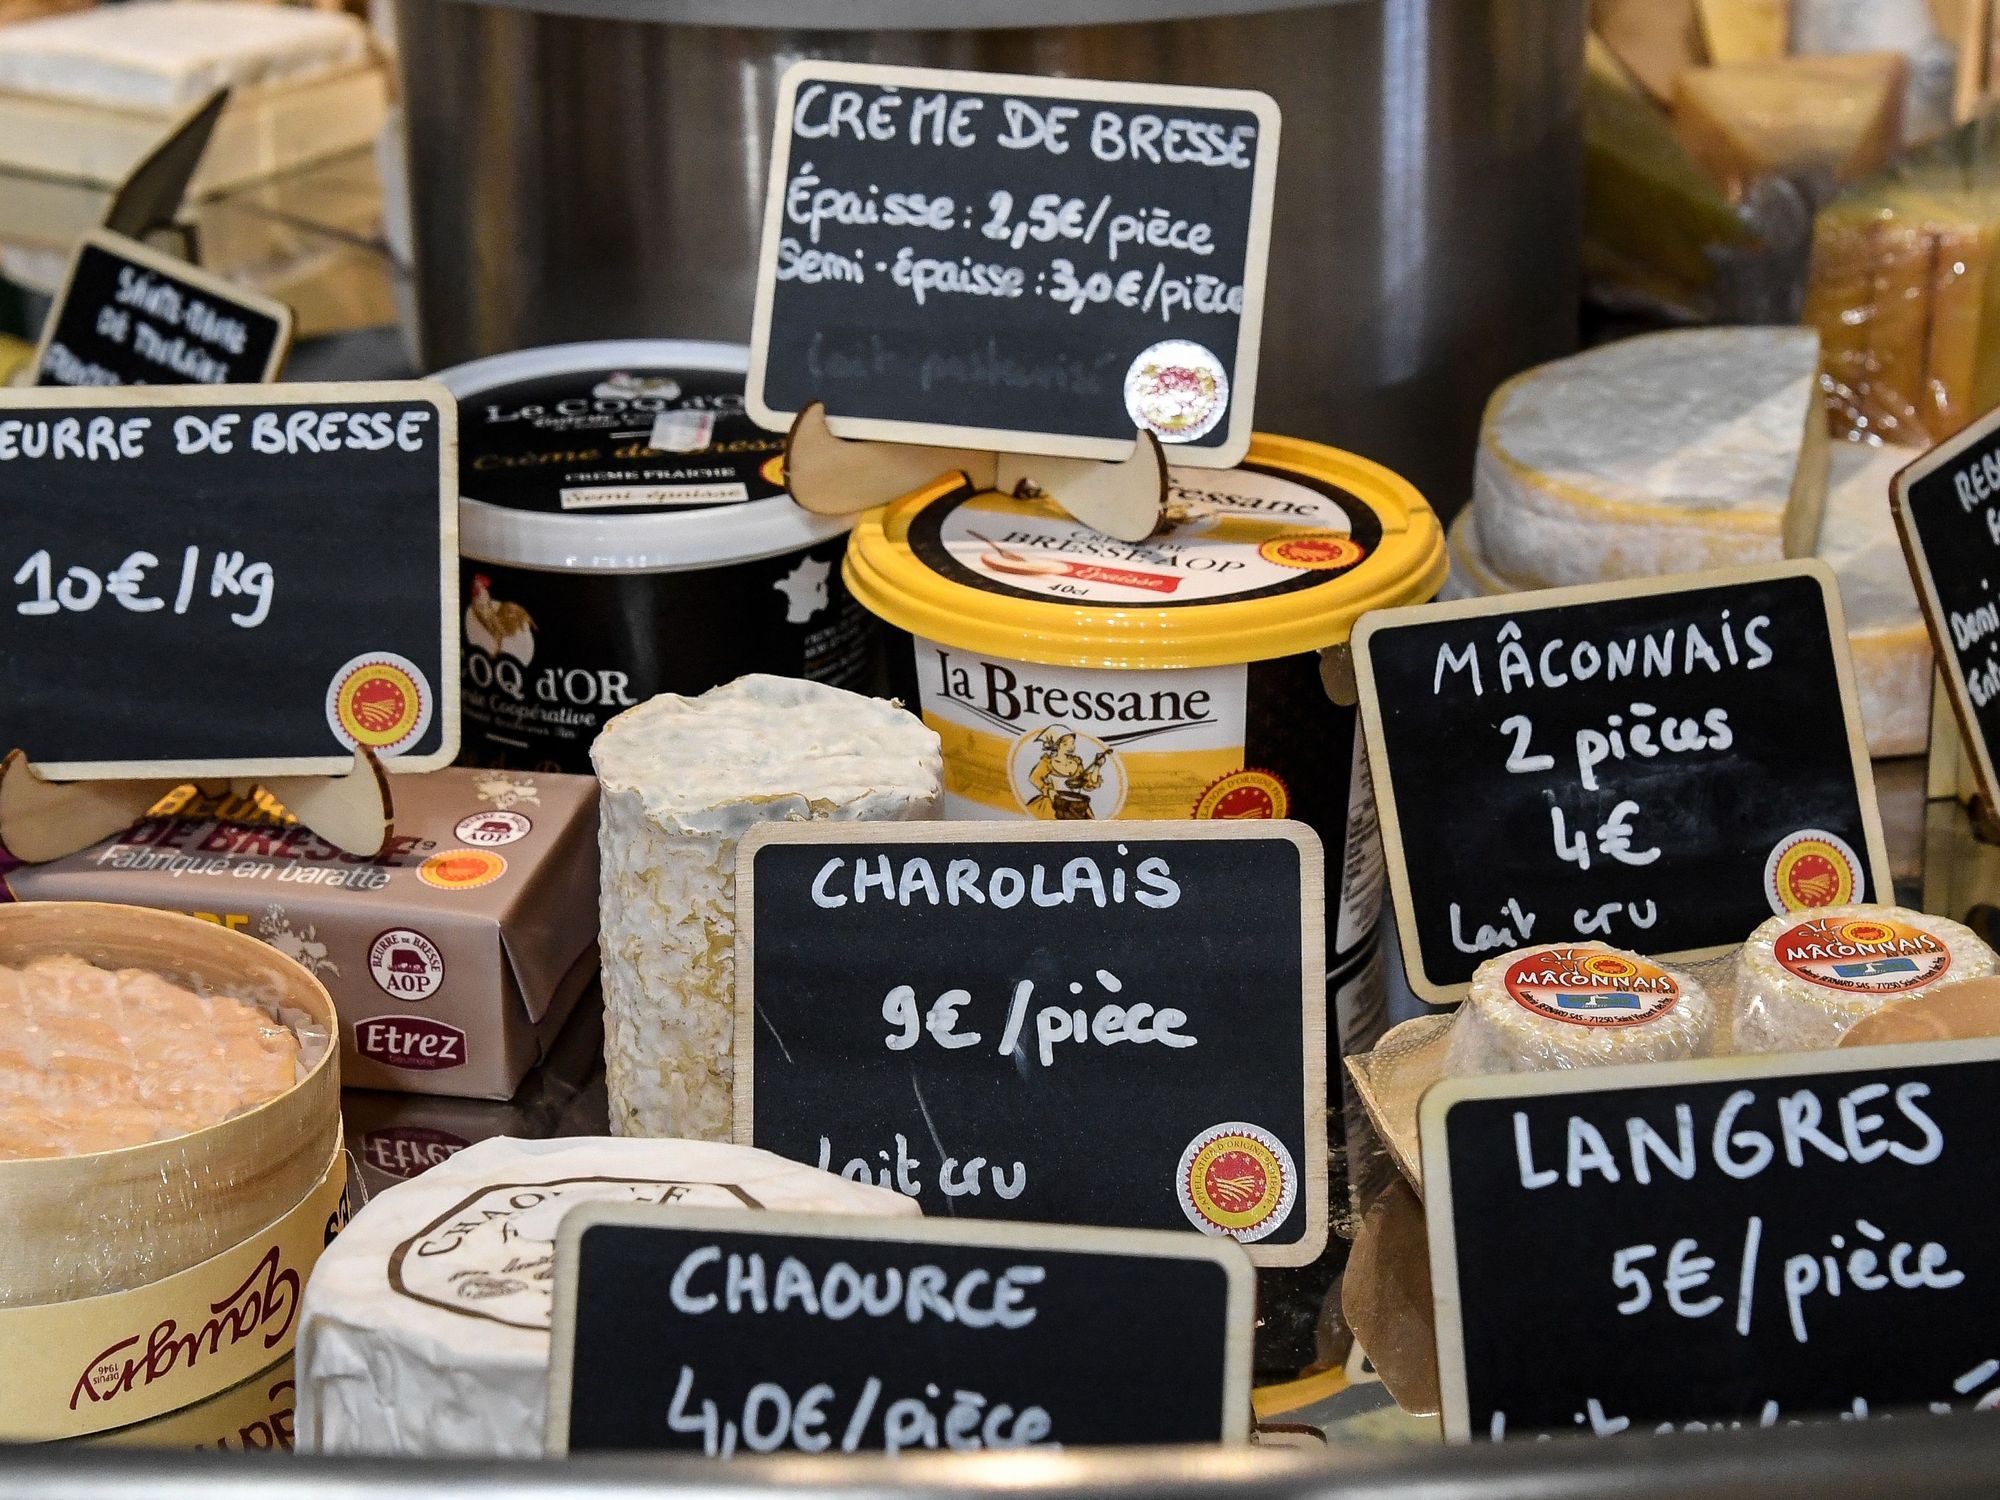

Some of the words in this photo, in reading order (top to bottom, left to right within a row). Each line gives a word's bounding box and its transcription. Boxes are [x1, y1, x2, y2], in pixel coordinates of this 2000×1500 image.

[997, 98, 1081, 155] DE
[1090, 111, 1257, 169] BRESSE
[173, 413, 241, 455] DE
[250, 410, 431, 454] BRESSE
[535, 667, 639, 707] d'OR
[979, 661, 1213, 723] Bressane
[1501, 714, 1555, 773] 2
[1576, 702, 1735, 792] pièces
[1550, 800, 1662, 870] 4€
[98, 844, 231, 879] Fabriqué
[232, 860, 273, 880] en
[278, 859, 392, 891] baratte
[1573, 899, 1658, 936] cru
[1786, 934, 1937, 962] MÂCONNAIS
[386, 973, 431, 993] AOP
[1516, 970, 1673, 991] MÂCONNAIS
[1567, 1011, 1583, 1021] SAS
[1589, 1014, 1614, 1024] 71250
[366, 1025, 459, 1060] Etrez
[1512, 1082, 1944, 1190] LANGRES
[939, 1157, 1026, 1199] cru
[669, 1246, 1046, 1330] CHAOURCE
[69, 1246, 301, 1411] Gaugry
[92, 1371, 120, 1386] DEPUIS
[97, 1362, 119, 1375] 1946
